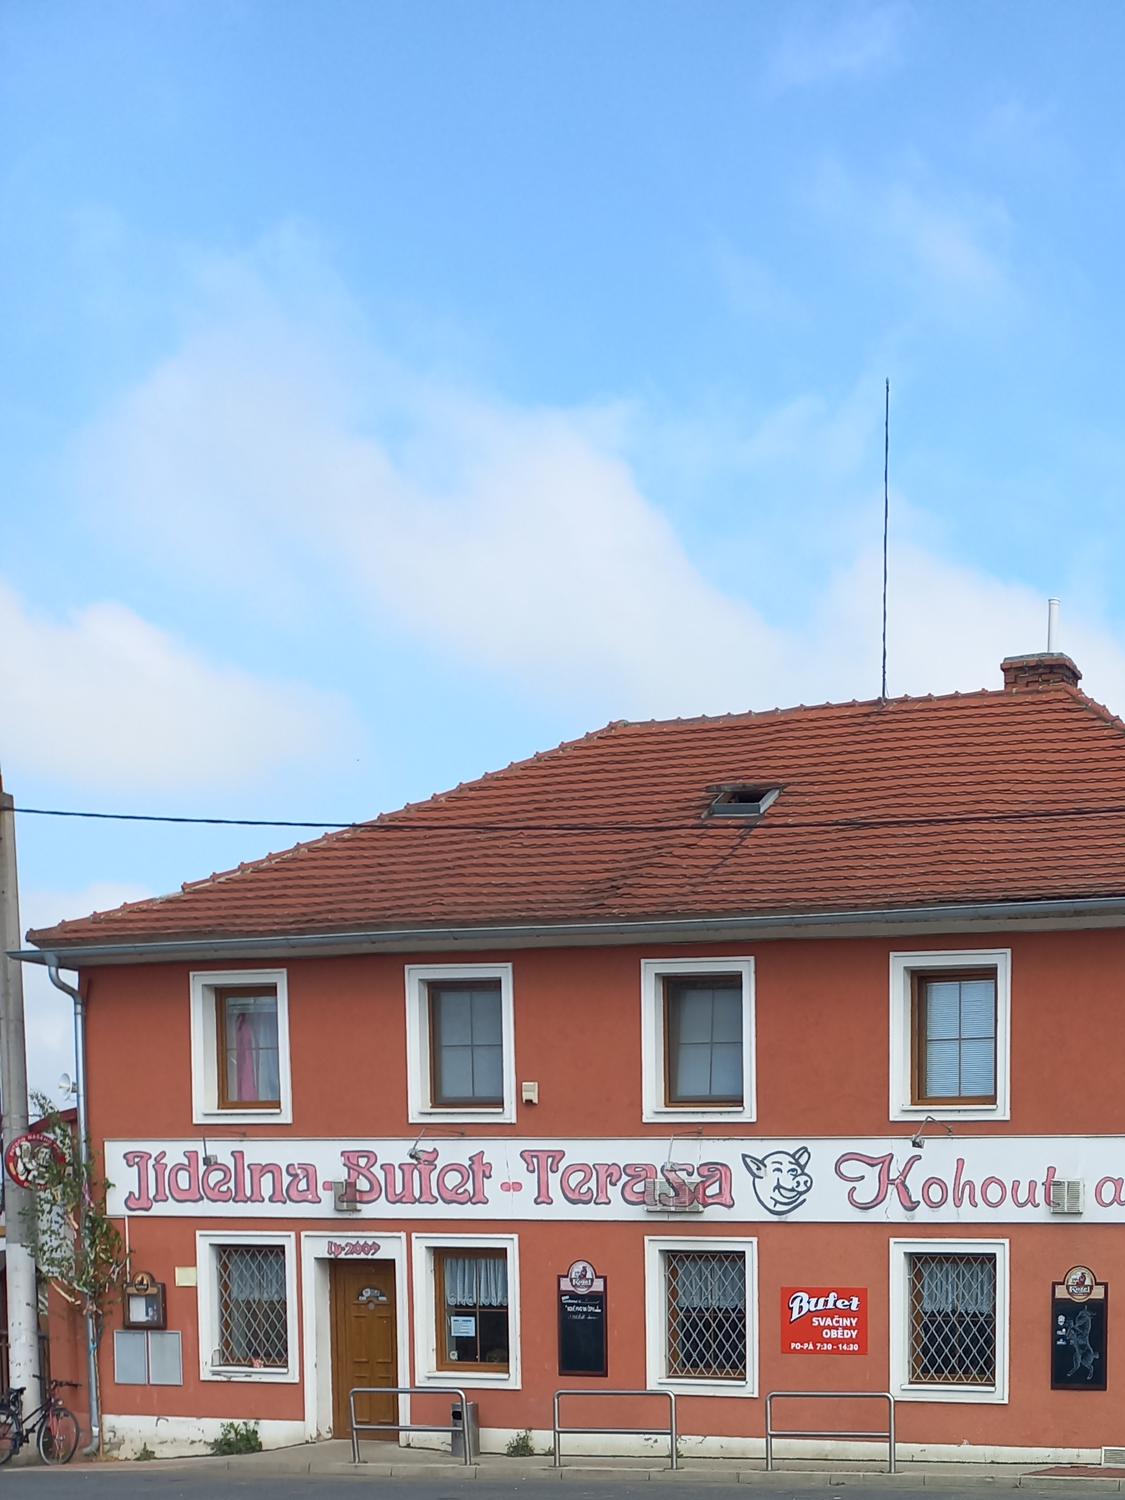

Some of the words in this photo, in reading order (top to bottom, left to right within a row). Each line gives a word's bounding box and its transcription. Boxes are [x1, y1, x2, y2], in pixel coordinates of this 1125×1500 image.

[834, 1151, 1060, 1212] Kohout
[788, 1291, 861, 1323] Bufet
[811, 1315, 858, 1327] SVAČINY
[822, 1328, 858, 1339] OBĚDY
